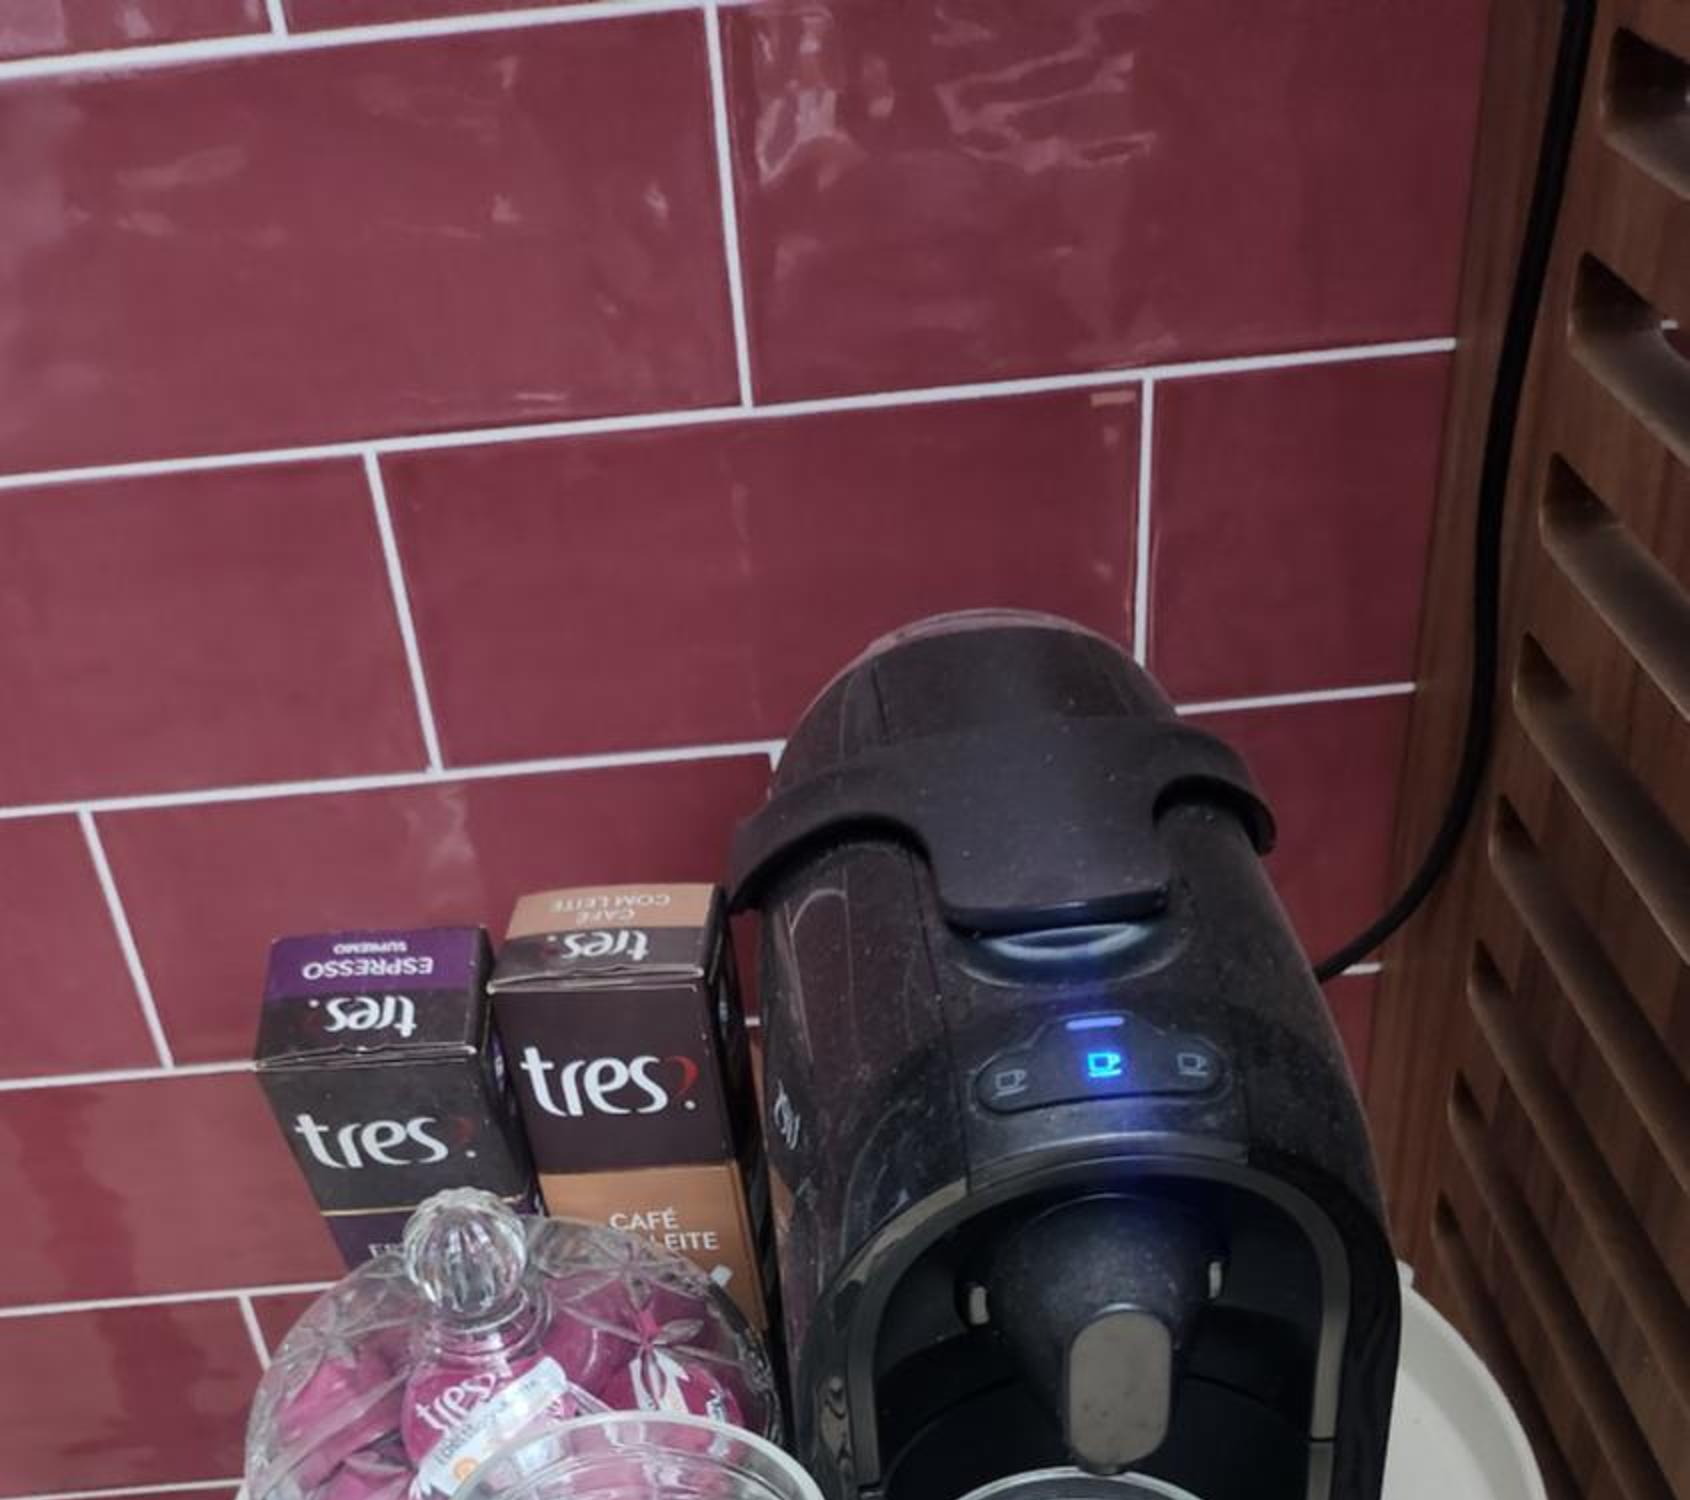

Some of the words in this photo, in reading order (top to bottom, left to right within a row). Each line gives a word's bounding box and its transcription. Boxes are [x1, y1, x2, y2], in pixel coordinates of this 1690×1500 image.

[333, 940, 408, 956] SUPREMO
[302, 956, 434, 981] ESPRESSO
[608, 1206, 681, 1231] CAFÉ
